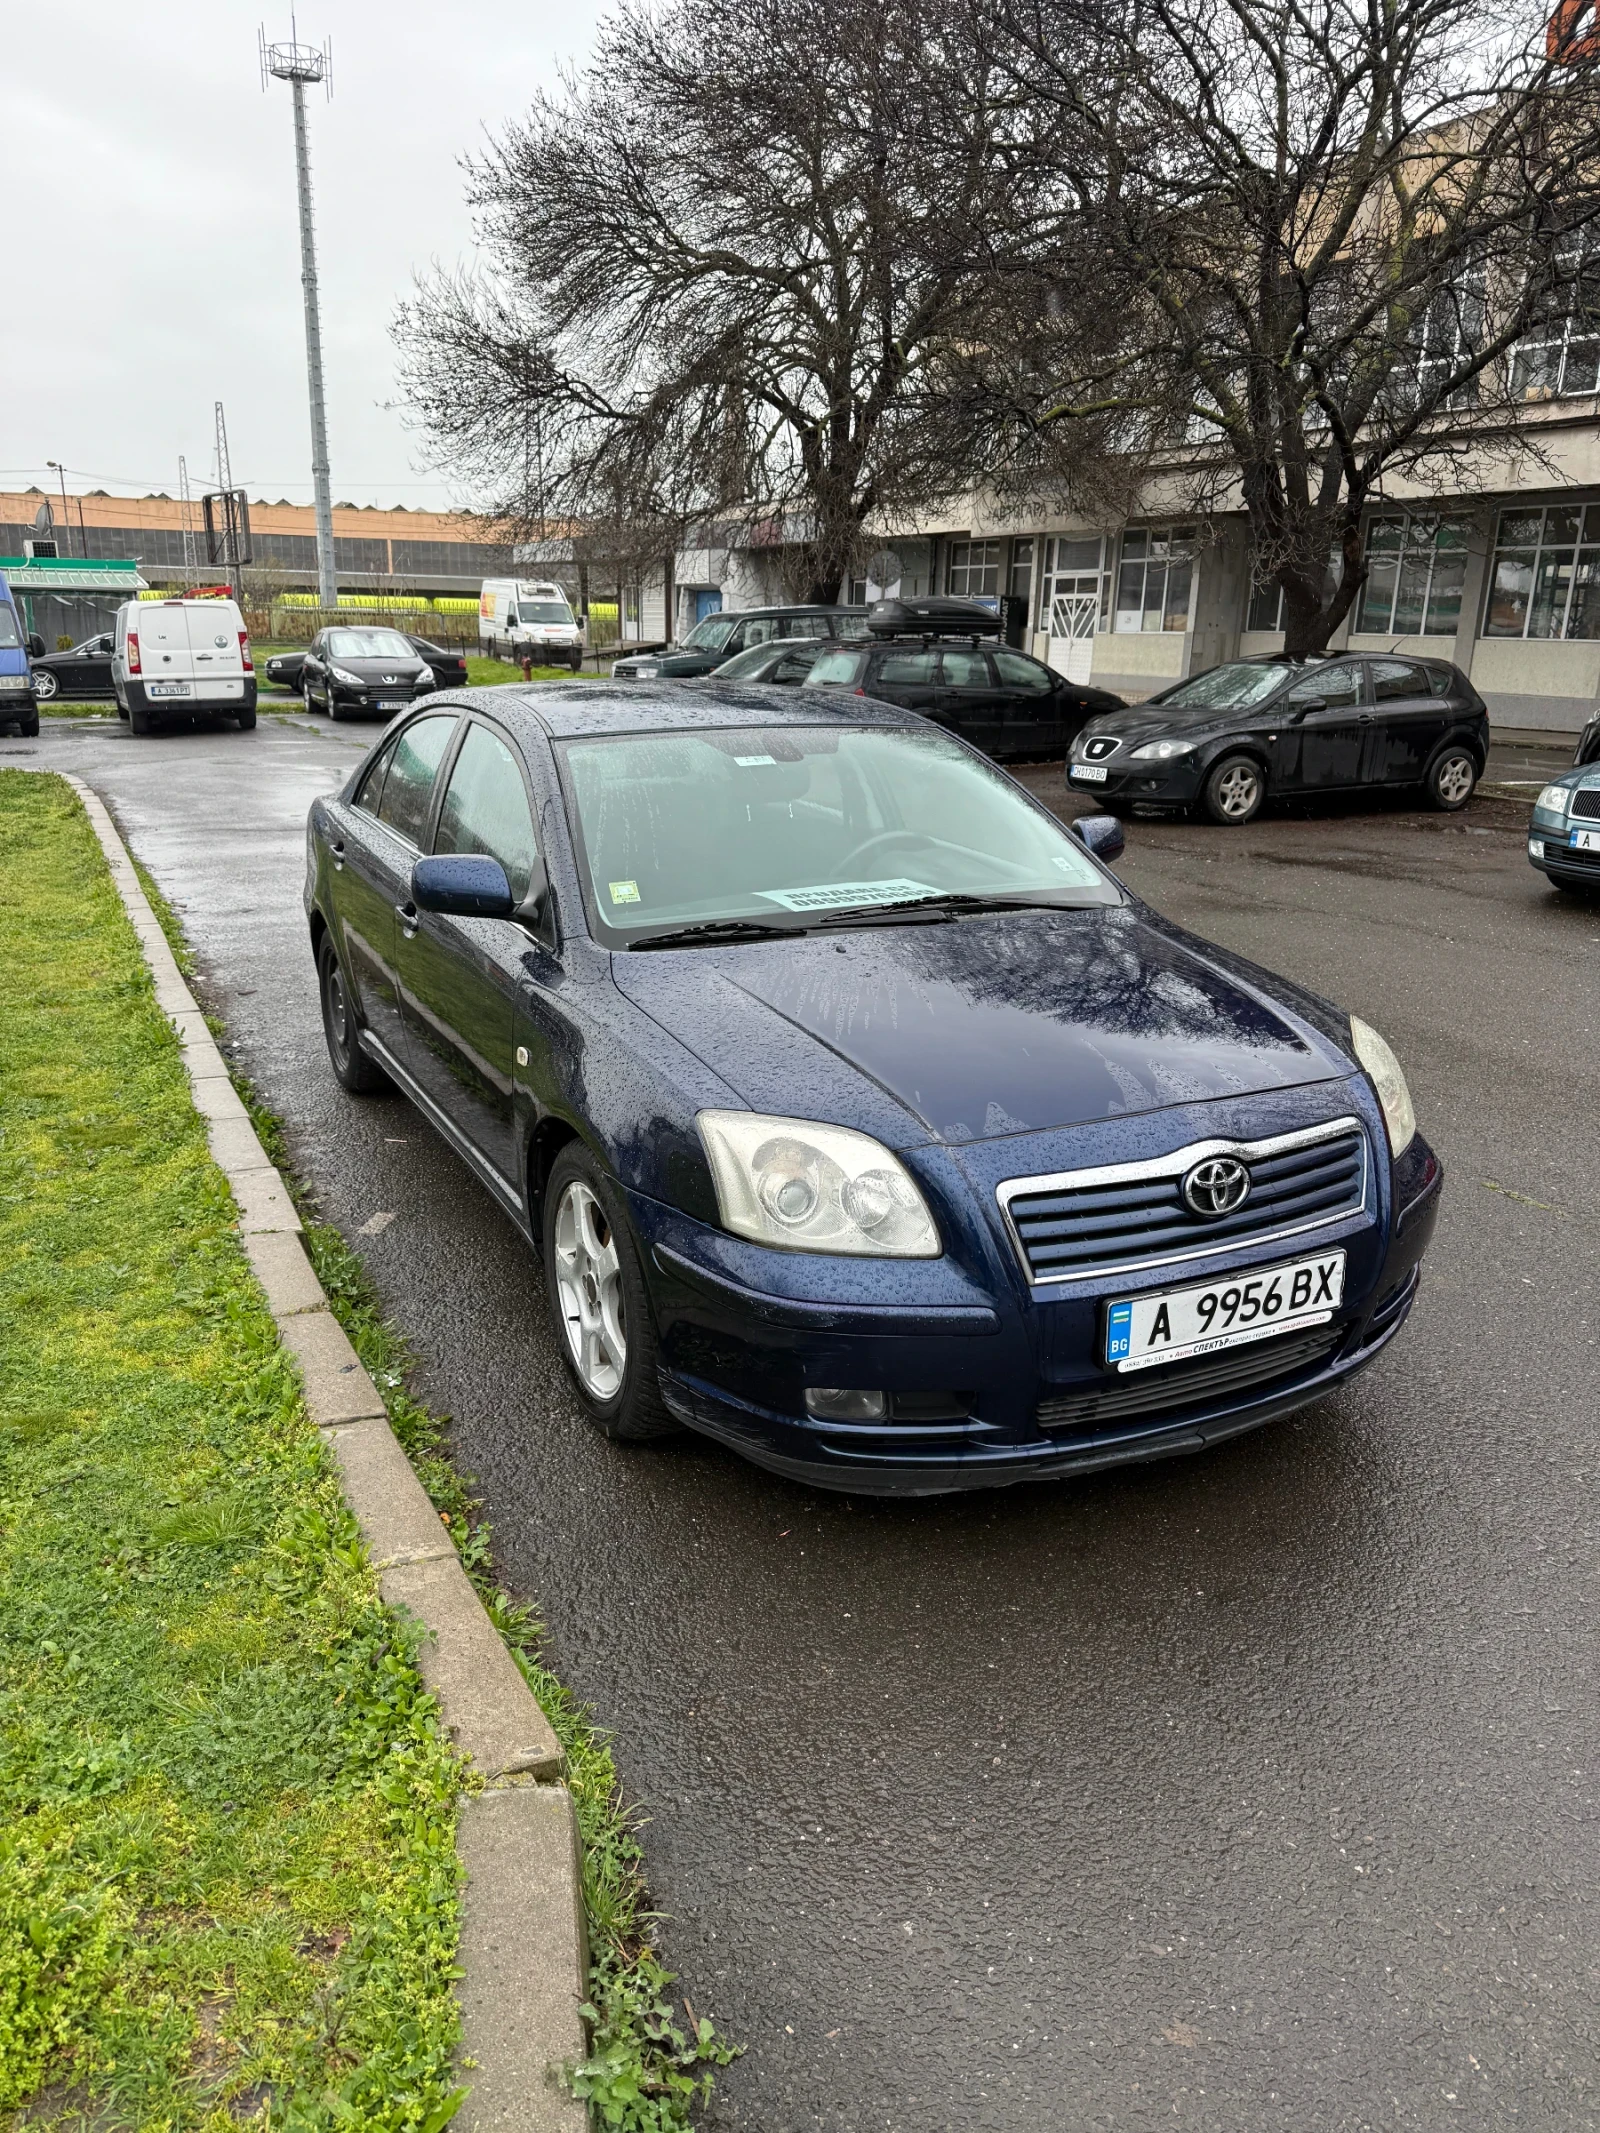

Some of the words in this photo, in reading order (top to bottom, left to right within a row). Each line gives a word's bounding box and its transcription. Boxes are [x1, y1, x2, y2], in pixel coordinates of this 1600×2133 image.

[1582, 833, 1590, 847] A
[1147, 1302, 1172, 1346] A
[1197, 1276, 1283, 1334] 9956
[1289, 1261, 1338, 1310] BX
[1111, 1338, 1128, 1353] BG
[1193, 1338, 1230, 1353] СПЕКТЪР
